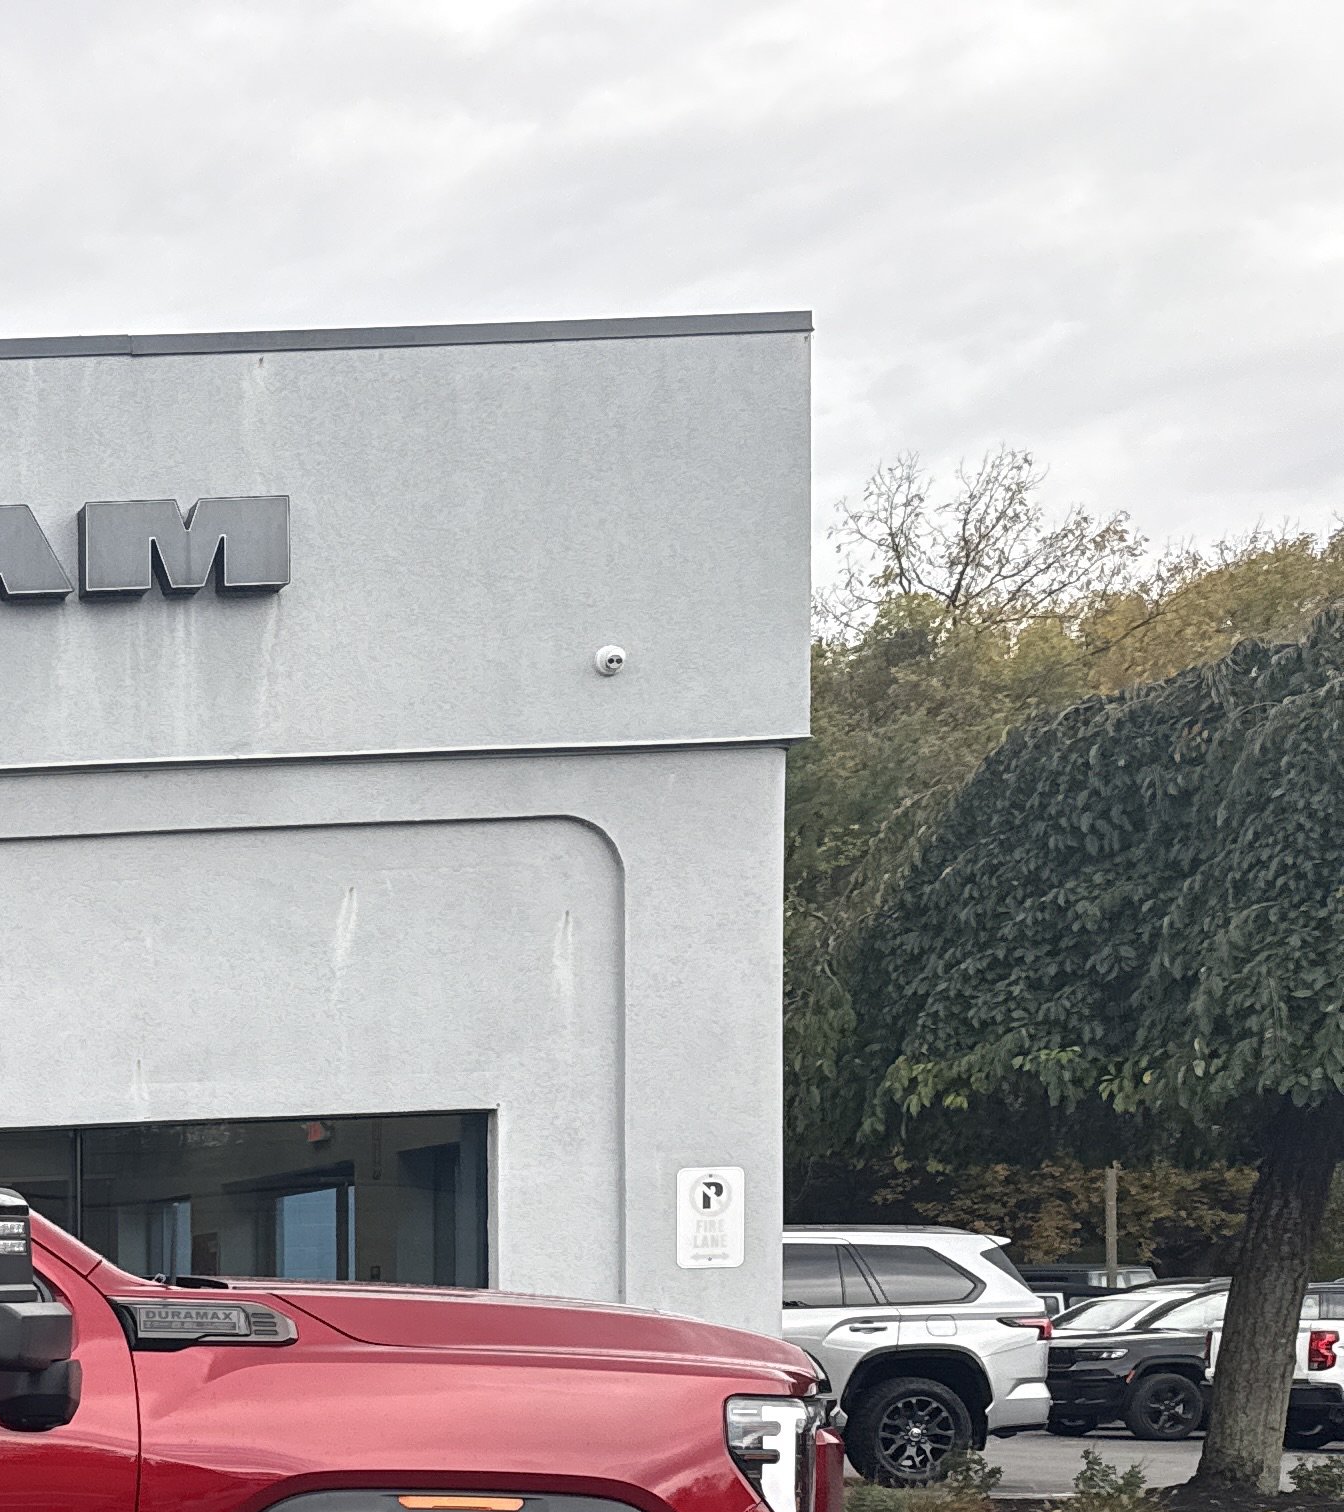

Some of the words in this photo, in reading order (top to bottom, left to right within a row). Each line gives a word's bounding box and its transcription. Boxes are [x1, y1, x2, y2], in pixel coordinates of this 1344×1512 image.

[695, 1219, 725, 1233] FIRE
[693, 1234, 729, 1248] LANE
[145, 1310, 233, 1321] DURAMAX
